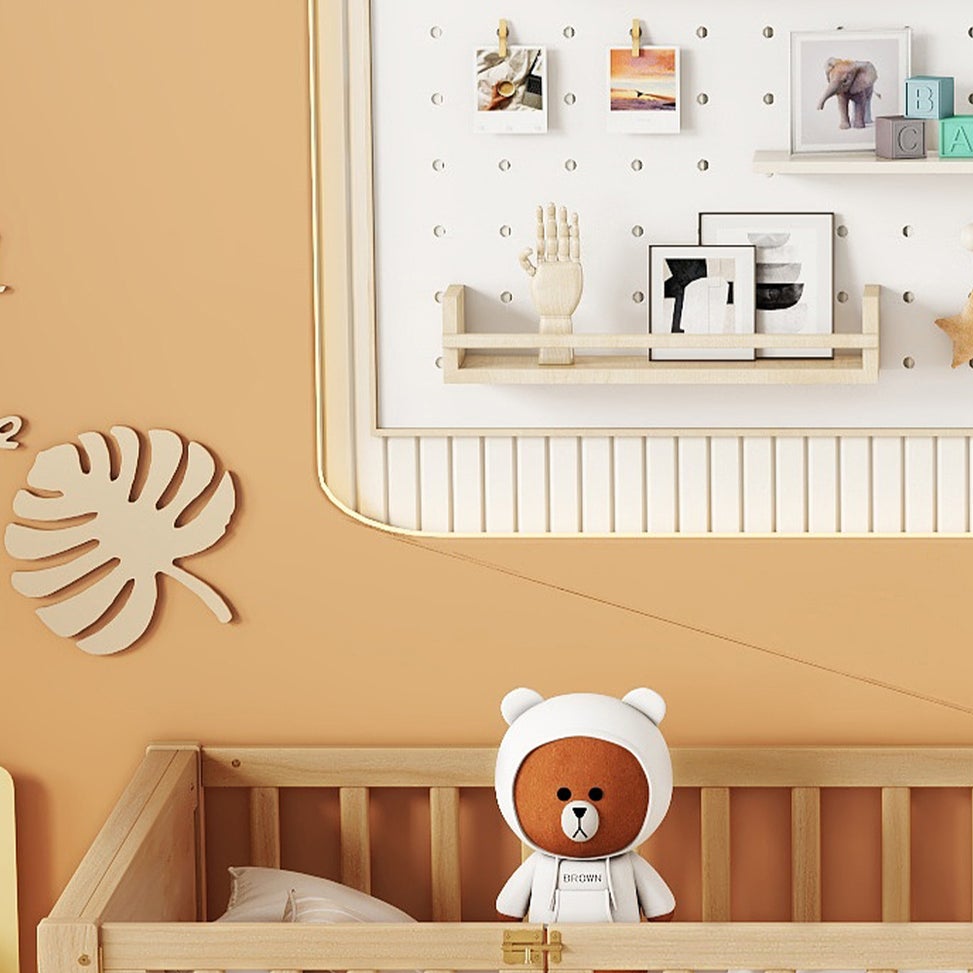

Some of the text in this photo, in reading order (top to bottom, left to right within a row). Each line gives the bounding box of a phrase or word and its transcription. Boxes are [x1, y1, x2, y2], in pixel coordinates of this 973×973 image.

[897, 125, 917, 152] C
[950, 125, 973, 152] A
[563, 873, 602, 883] BROWN
